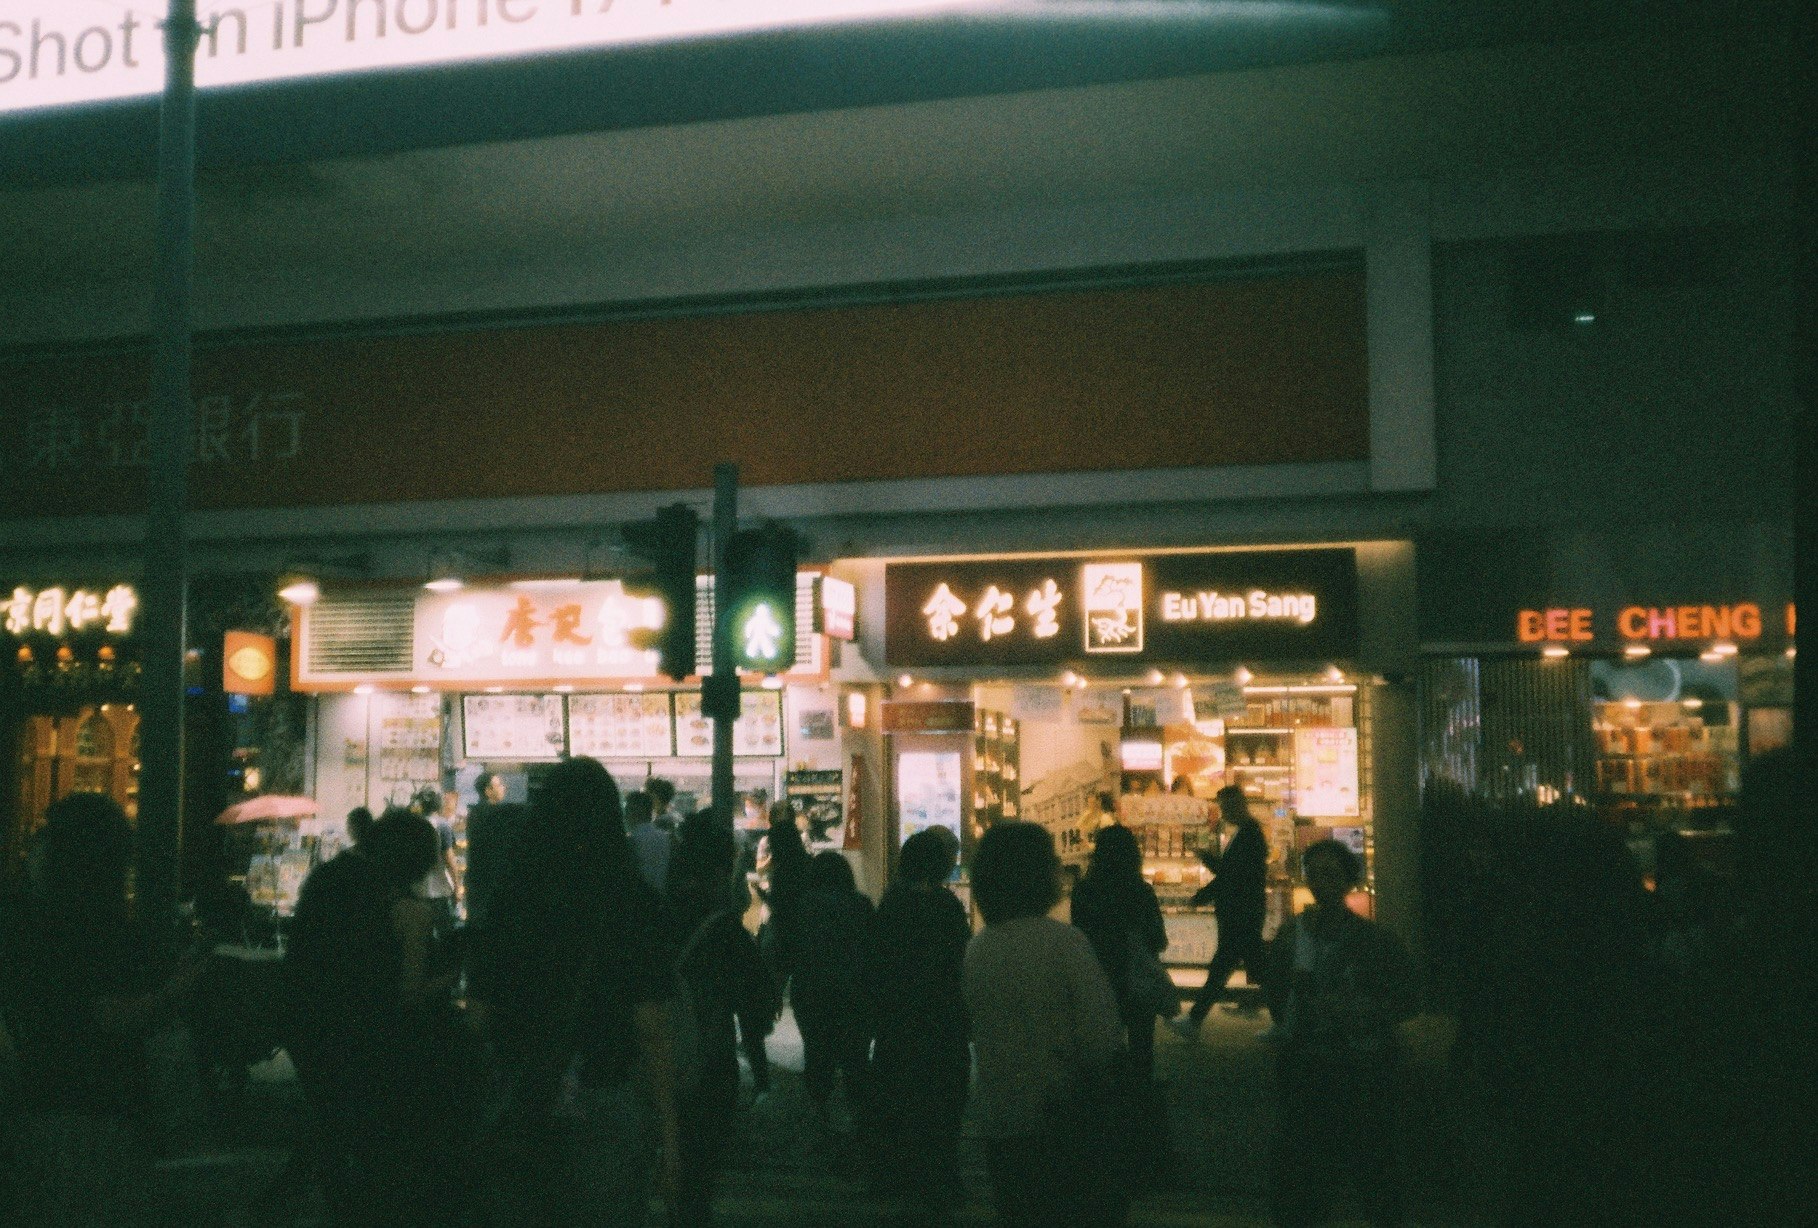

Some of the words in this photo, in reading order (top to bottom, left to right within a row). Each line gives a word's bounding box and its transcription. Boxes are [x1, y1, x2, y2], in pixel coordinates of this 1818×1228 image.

[1162, 591, 1197, 620] Eu
[1198, 590, 1246, 619] Yan
[1248, 589, 1315, 623] Sang
[1518, 608, 1593, 642] BEE
[1617, 602, 1762, 641] CHENG
